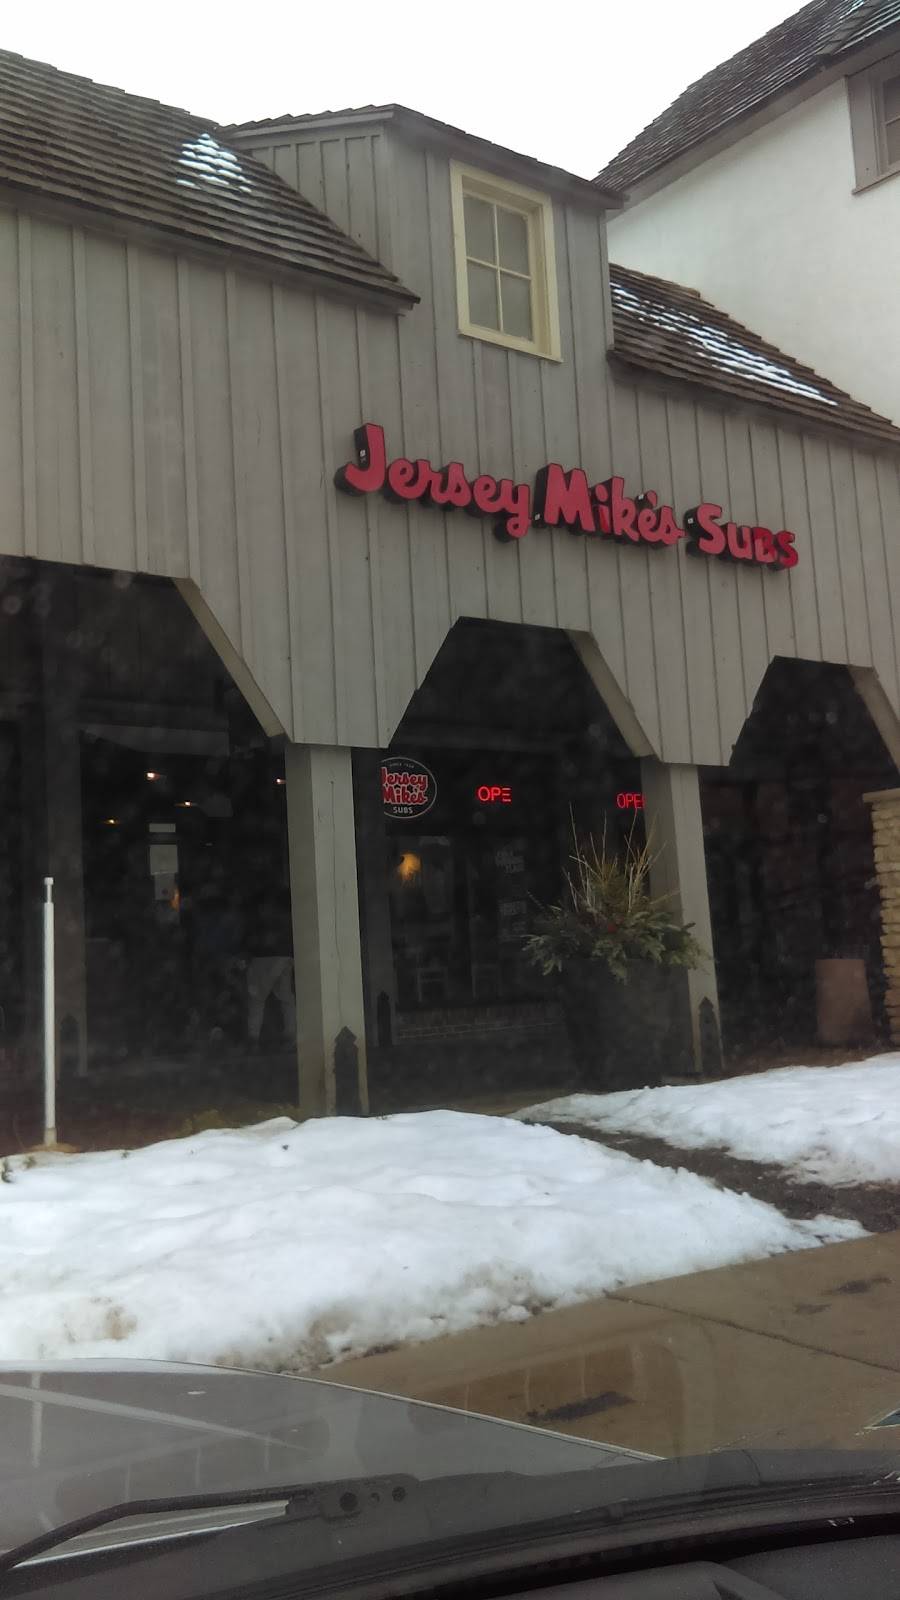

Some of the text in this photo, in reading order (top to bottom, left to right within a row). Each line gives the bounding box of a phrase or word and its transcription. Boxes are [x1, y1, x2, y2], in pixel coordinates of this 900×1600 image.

[340, 422, 533, 539] Jersey
[541, 462, 687, 547] Mike's
[617, 793, 646, 809] OPE
[393, 806, 413, 814] SUBS
